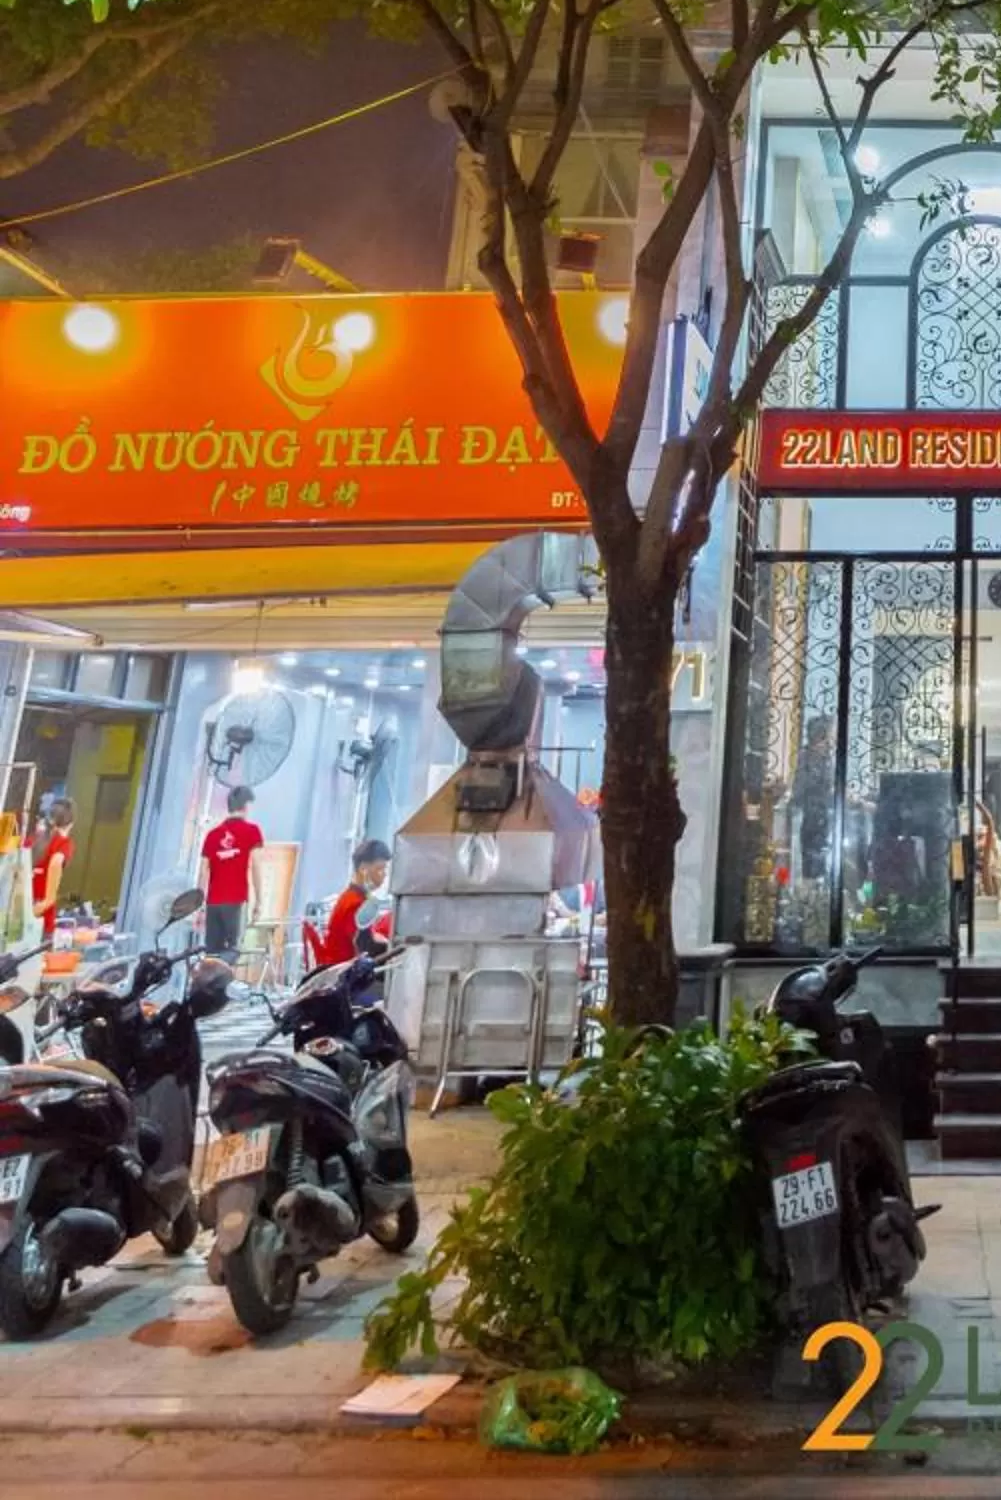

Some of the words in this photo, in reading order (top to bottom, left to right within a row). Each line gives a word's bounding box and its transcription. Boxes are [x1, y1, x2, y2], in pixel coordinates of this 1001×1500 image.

[18, 416, 96, 473] ĐỒ
[316, 417, 444, 467] THÁI
[457, 425, 561, 472] ĐẠT
[782, 428, 902, 469] 22LAND
